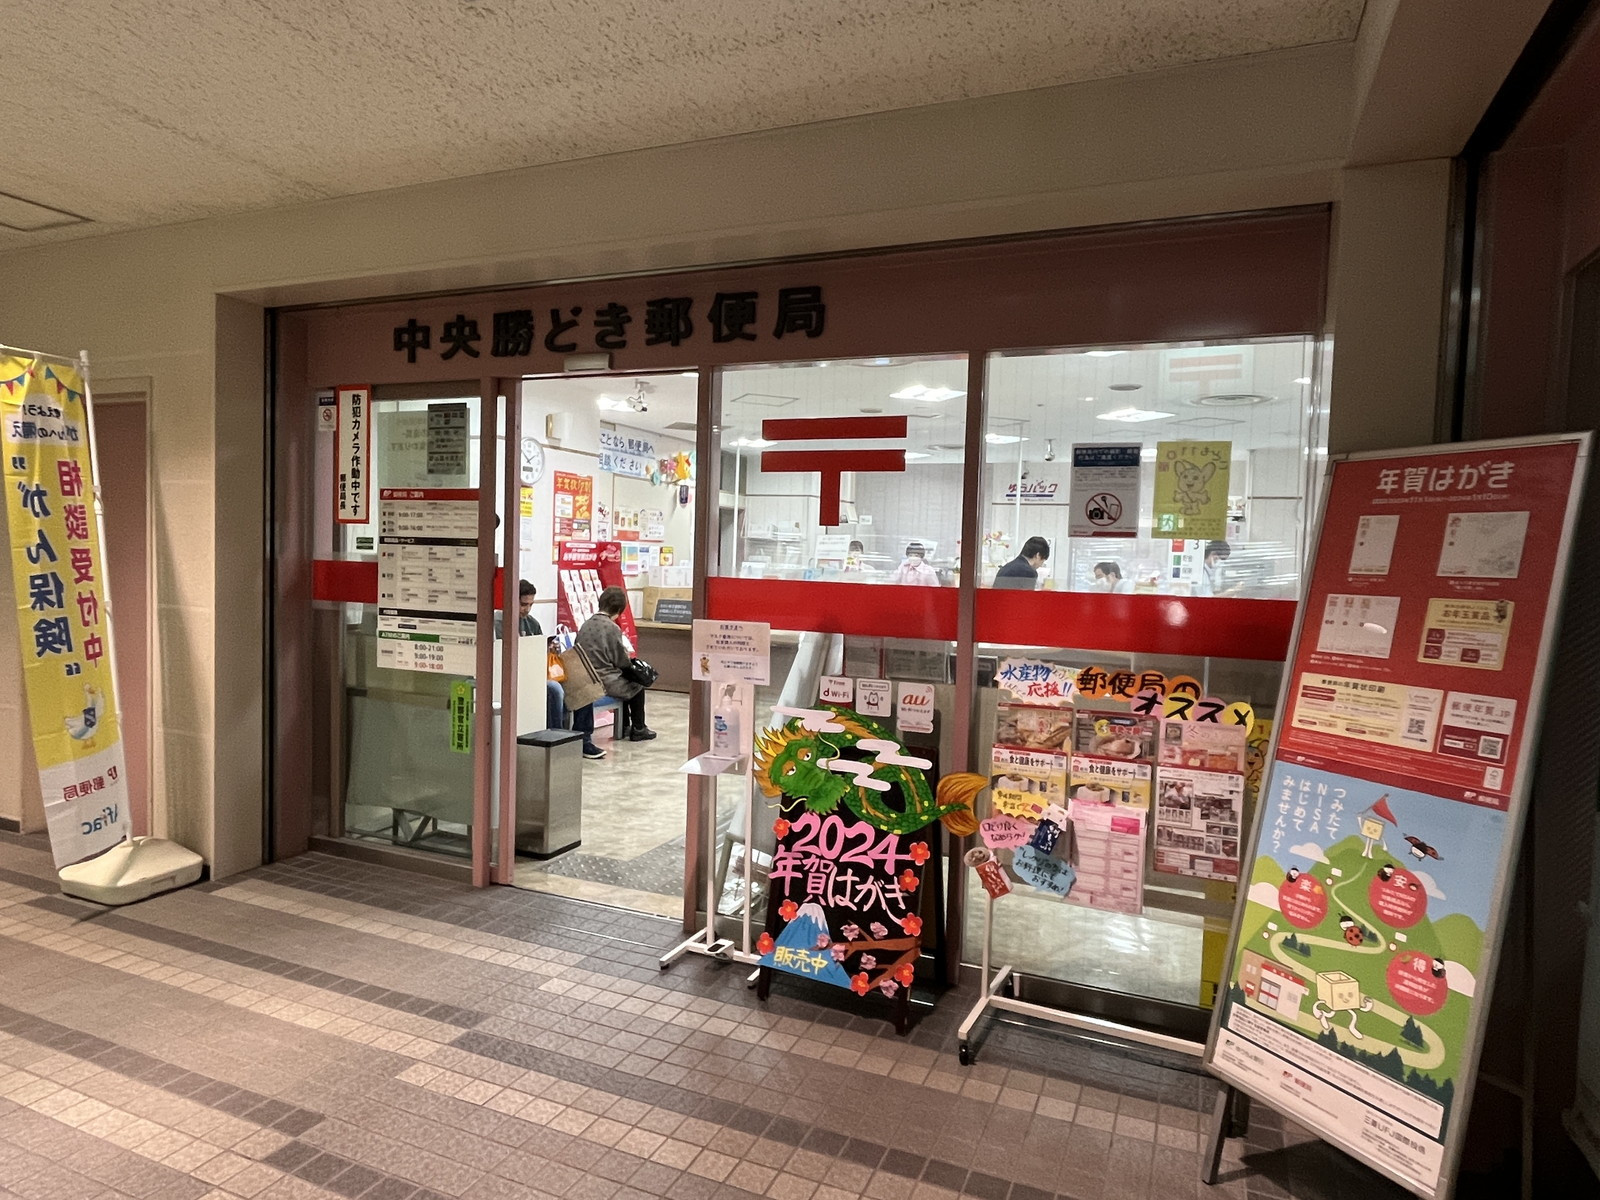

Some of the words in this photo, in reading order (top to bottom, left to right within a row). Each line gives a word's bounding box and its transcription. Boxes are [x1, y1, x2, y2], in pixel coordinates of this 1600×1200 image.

[393, 286, 826, 363] 中央勝どき郵便局
[351, 393, 362, 516] 防犯カメラ作動中です
[339, 473, 347, 510] 郵便局長
[1376, 460, 1515, 494] 年賀はがき
[1000, 663, 1051, 682] 水産物
[1076, 666, 1201, 700] 郵便局の
[831, 690, 850, 699] Wi-Fi
[902, 693, 930, 706] au
[1131, 691, 1252, 727] オススメ
[1009, 755, 1054, 768] 食と健康をサポート
[1089, 763, 1137, 779] 食と健康をサポート
[1272, 775, 1296, 853] みませんか?
[1292, 778, 1312, 832] はじめて
[1309, 782, 1328, 834] NISA
[1327, 787, 1347, 840] つみたて
[790, 812, 911, 875] 2024
[768, 844, 908, 926] 年賀はがき
[1299, 879, 1313, 893] 楽
[1393, 874, 1408, 889] 安
[773, 946, 829, 975] 販売中
